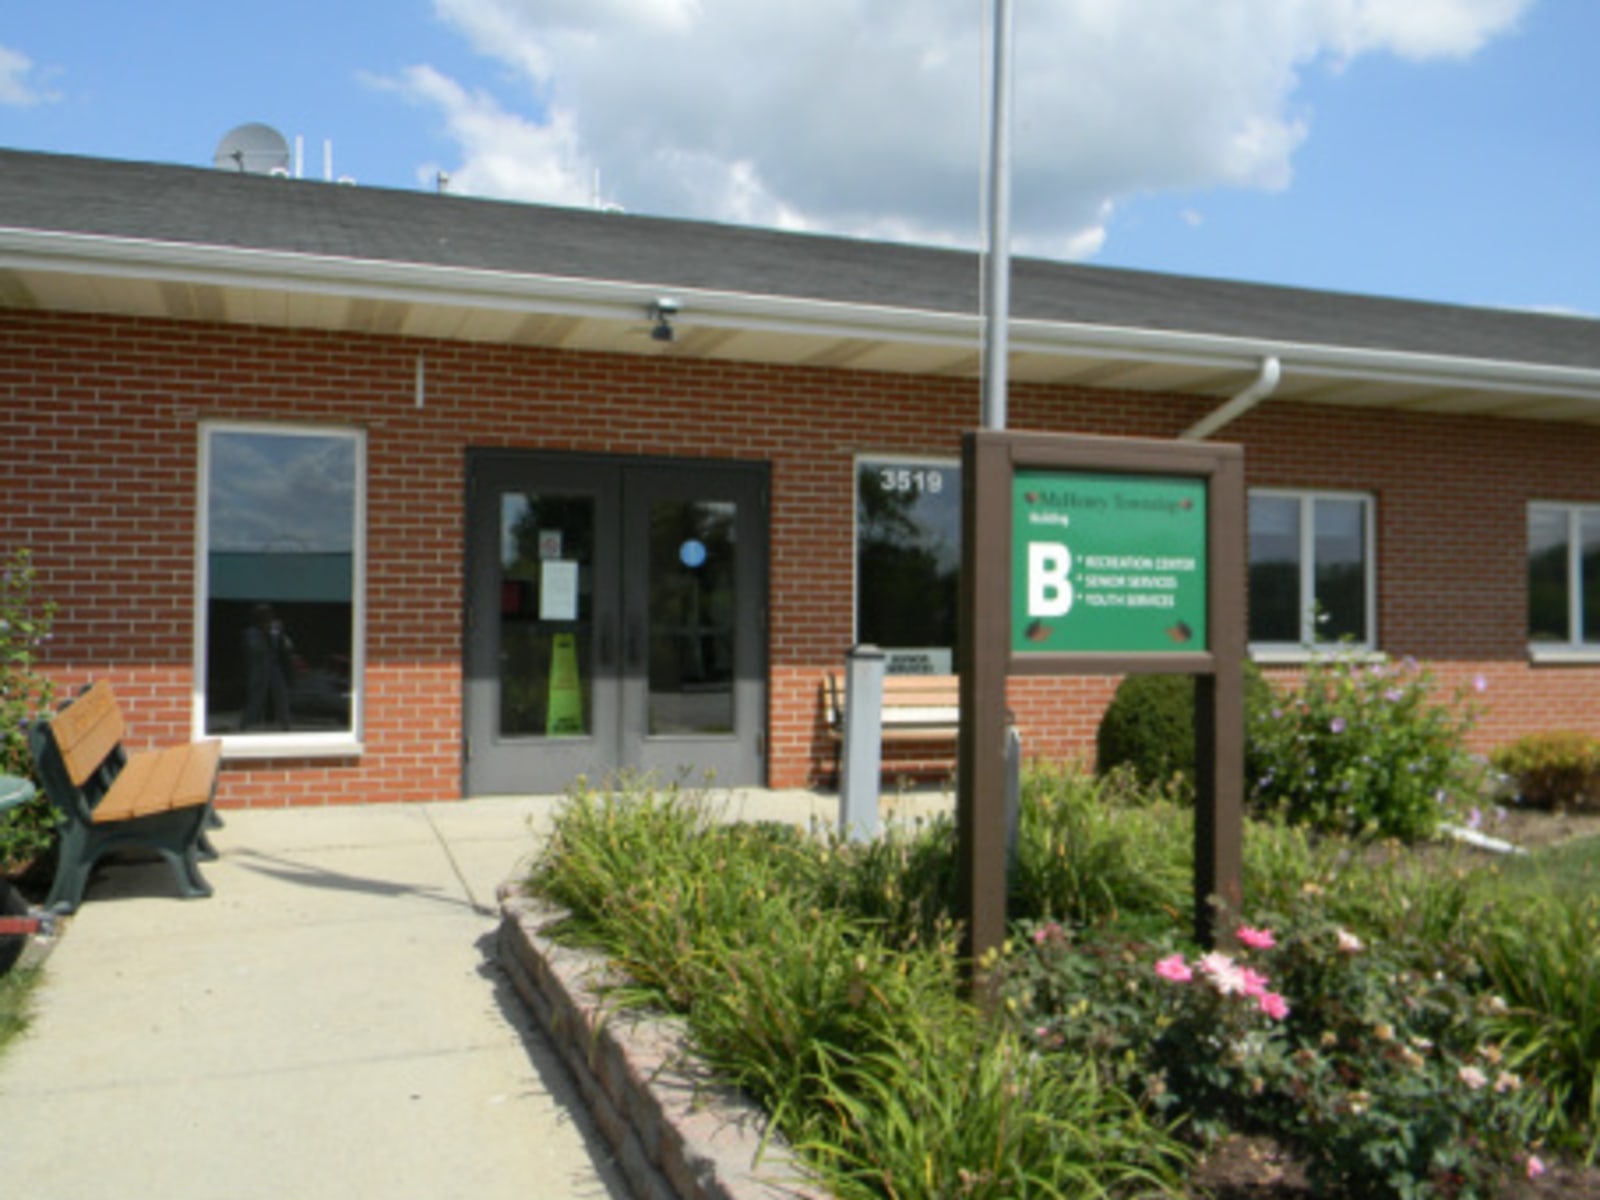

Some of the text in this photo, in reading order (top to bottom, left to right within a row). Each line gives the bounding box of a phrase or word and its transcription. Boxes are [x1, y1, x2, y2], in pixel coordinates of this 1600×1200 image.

[880, 471, 943, 494] 3519
[1085, 556, 1195, 571] RECREATION CENTER
[1028, 542, 1072, 617] B
[1086, 574, 1178, 589] SENIOR SERVICES
[1086, 594, 1175, 608] YOUTH SERVICES
